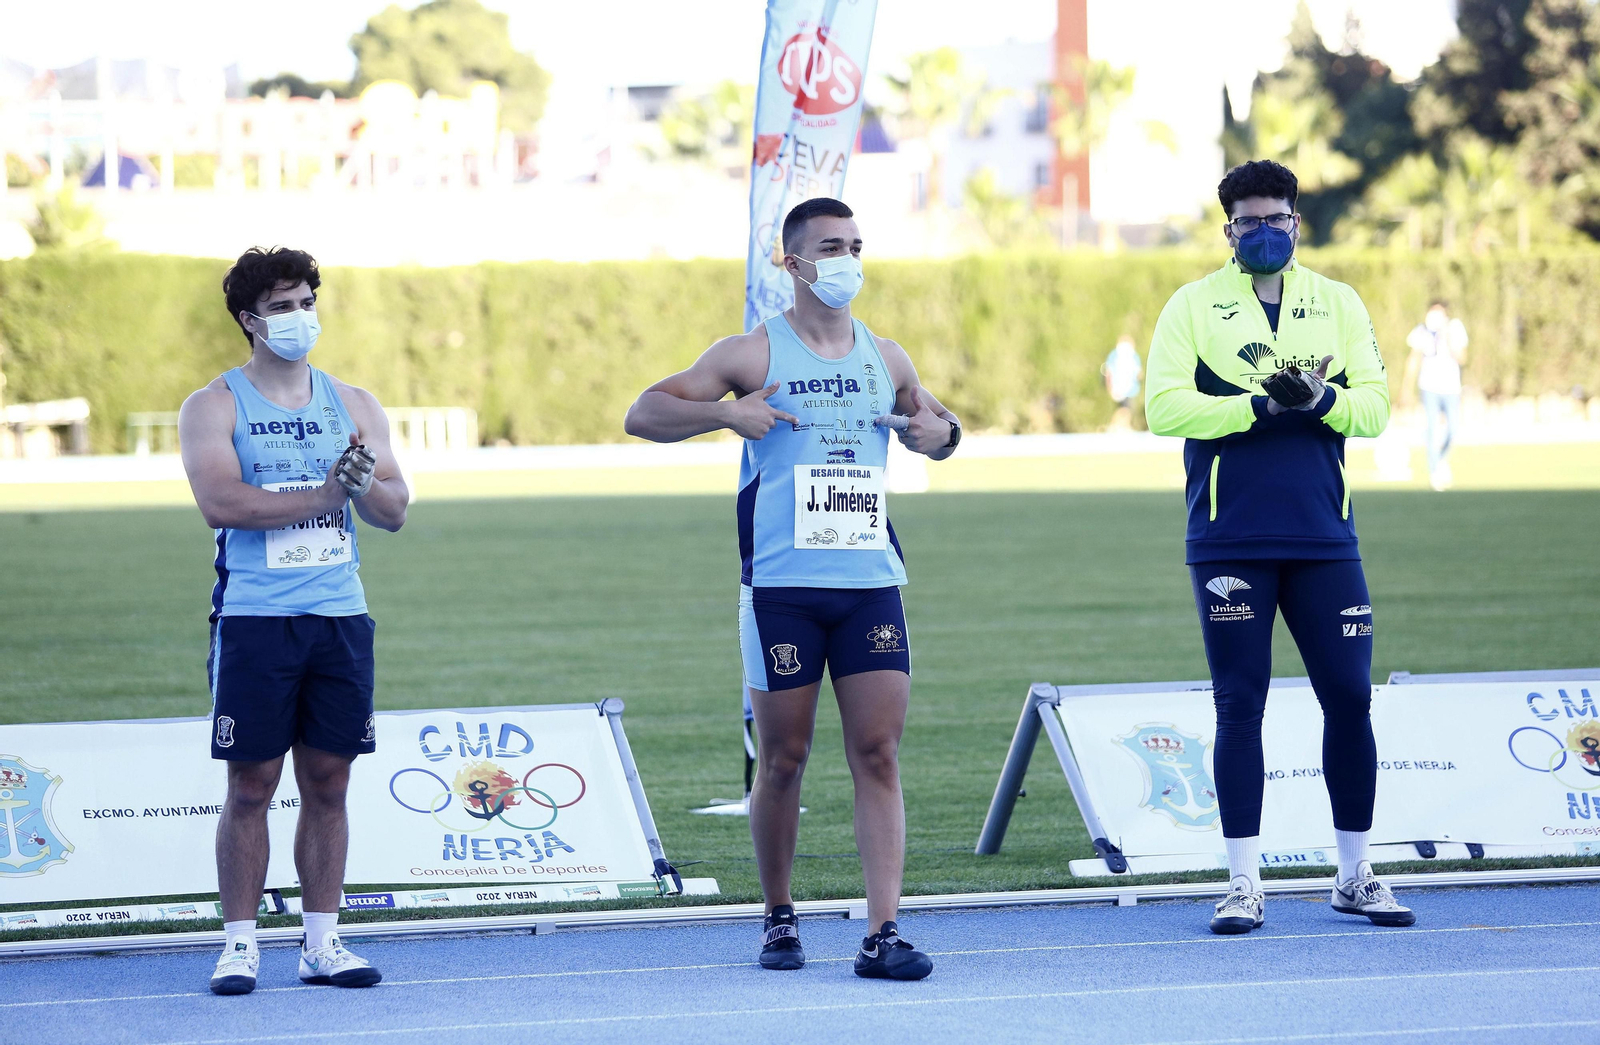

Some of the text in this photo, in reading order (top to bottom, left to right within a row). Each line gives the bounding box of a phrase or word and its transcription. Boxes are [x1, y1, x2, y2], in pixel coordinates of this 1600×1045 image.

[1274, 355, 1321, 370] Unicaja
[788, 373, 861, 398] nerja
[802, 400, 853, 409] ATLETISMO
[249, 417, 323, 440] nerja
[263, 440, 316, 450] ATLETISMO
[810, 467, 871, 478] DESAFÍO NERJA
[806, 485, 820, 512] J.
[823, 485, 878, 513] Jiménez
[869, 514, 878, 528] 2
[1210, 602, 1251, 613] Unicaja
[1527, 688, 1599, 721] CM
[418, 721, 535, 762] CMD
[1265, 769, 1290, 781] MO.
[1292, 767, 1325, 779] AYUN
[1394, 760, 1412, 770] DE
[1414, 760, 1458, 771] NERJA
[82, 808, 140, 819] EXCMO.
[142, 804, 223, 818] AYUNTAMIE
[281, 798, 300, 809] NE
[1259, 853, 1307, 867] nerj
[410, 864, 608, 877] Concejalia De Deportes
[476, 890, 538, 901] NERJA 2020
[66, 911, 130, 922] NERJA 2020
[766, 925, 792, 943] NIKE
